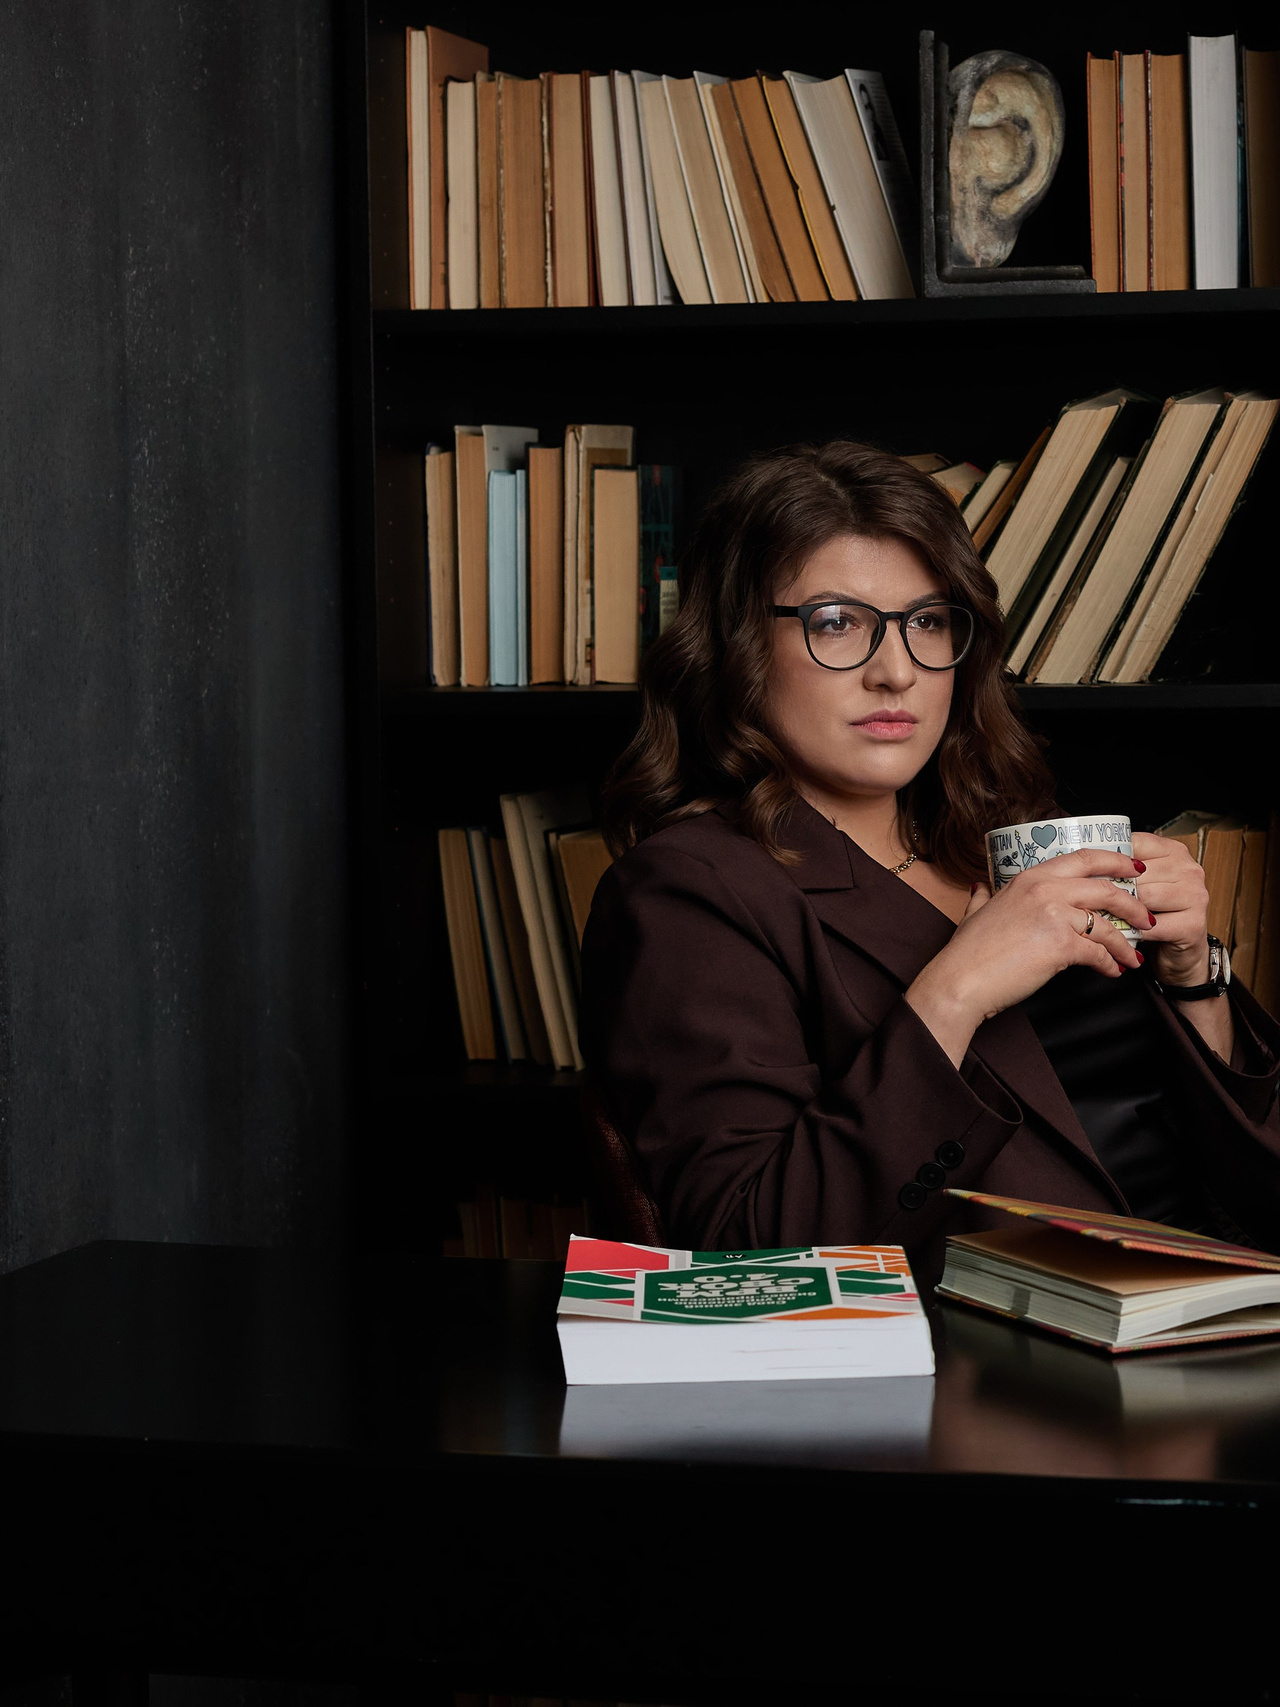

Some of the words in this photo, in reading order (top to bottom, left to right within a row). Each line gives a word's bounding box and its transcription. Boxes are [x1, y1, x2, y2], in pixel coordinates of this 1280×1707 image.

[1058, 824, 1092, 845] NEW
[1095, 823, 1126, 842] YORK
[693, 1273, 778, 1283] 4.0
[676, 1285, 798, 1297] BPM
